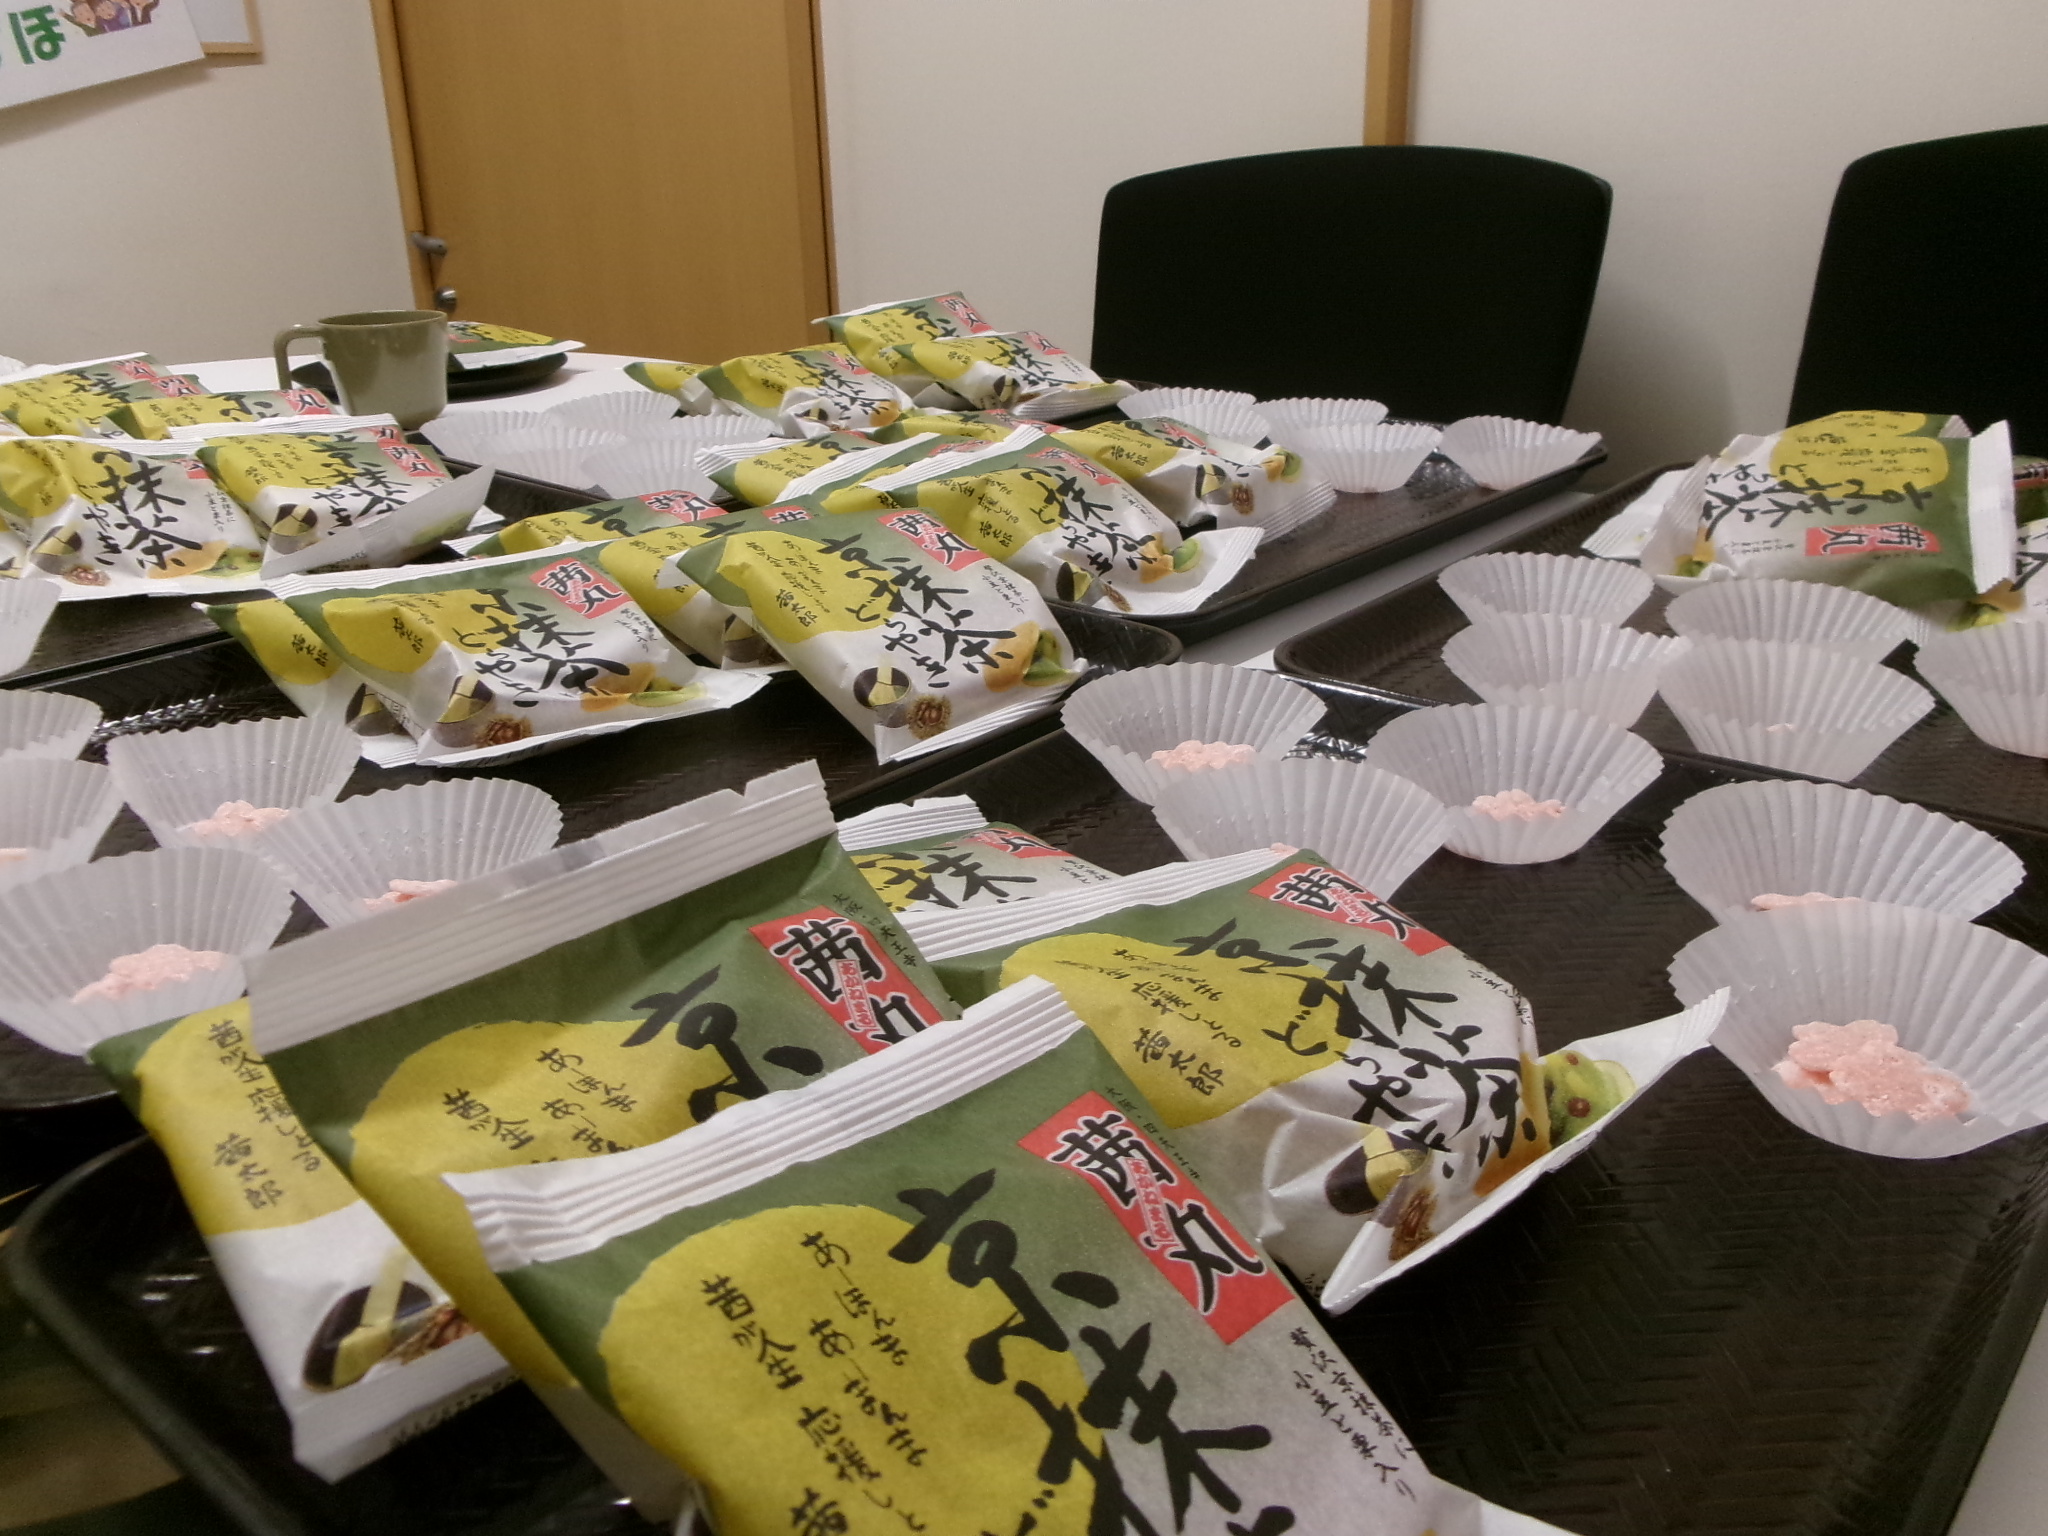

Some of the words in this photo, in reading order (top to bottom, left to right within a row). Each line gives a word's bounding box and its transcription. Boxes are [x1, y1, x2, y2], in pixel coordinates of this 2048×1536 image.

[8, 5, 66, 64] ほ
[888, 513, 979, 565] 茜丸
[1821, 524, 1927, 555] 茜丸
[539, 562, 622, 614] 茜丸
[817, 533, 1018, 675] 京抹茶
[845, 605, 951, 689] どらやき
[1273, 867, 1419, 940] 茜丸
[1051, 1111, 1265, 1313] 茜丸
[887, 1168, 1296, 1536] 京抹
[1291, 1368, 1419, 1504] 小豆と栗入り
